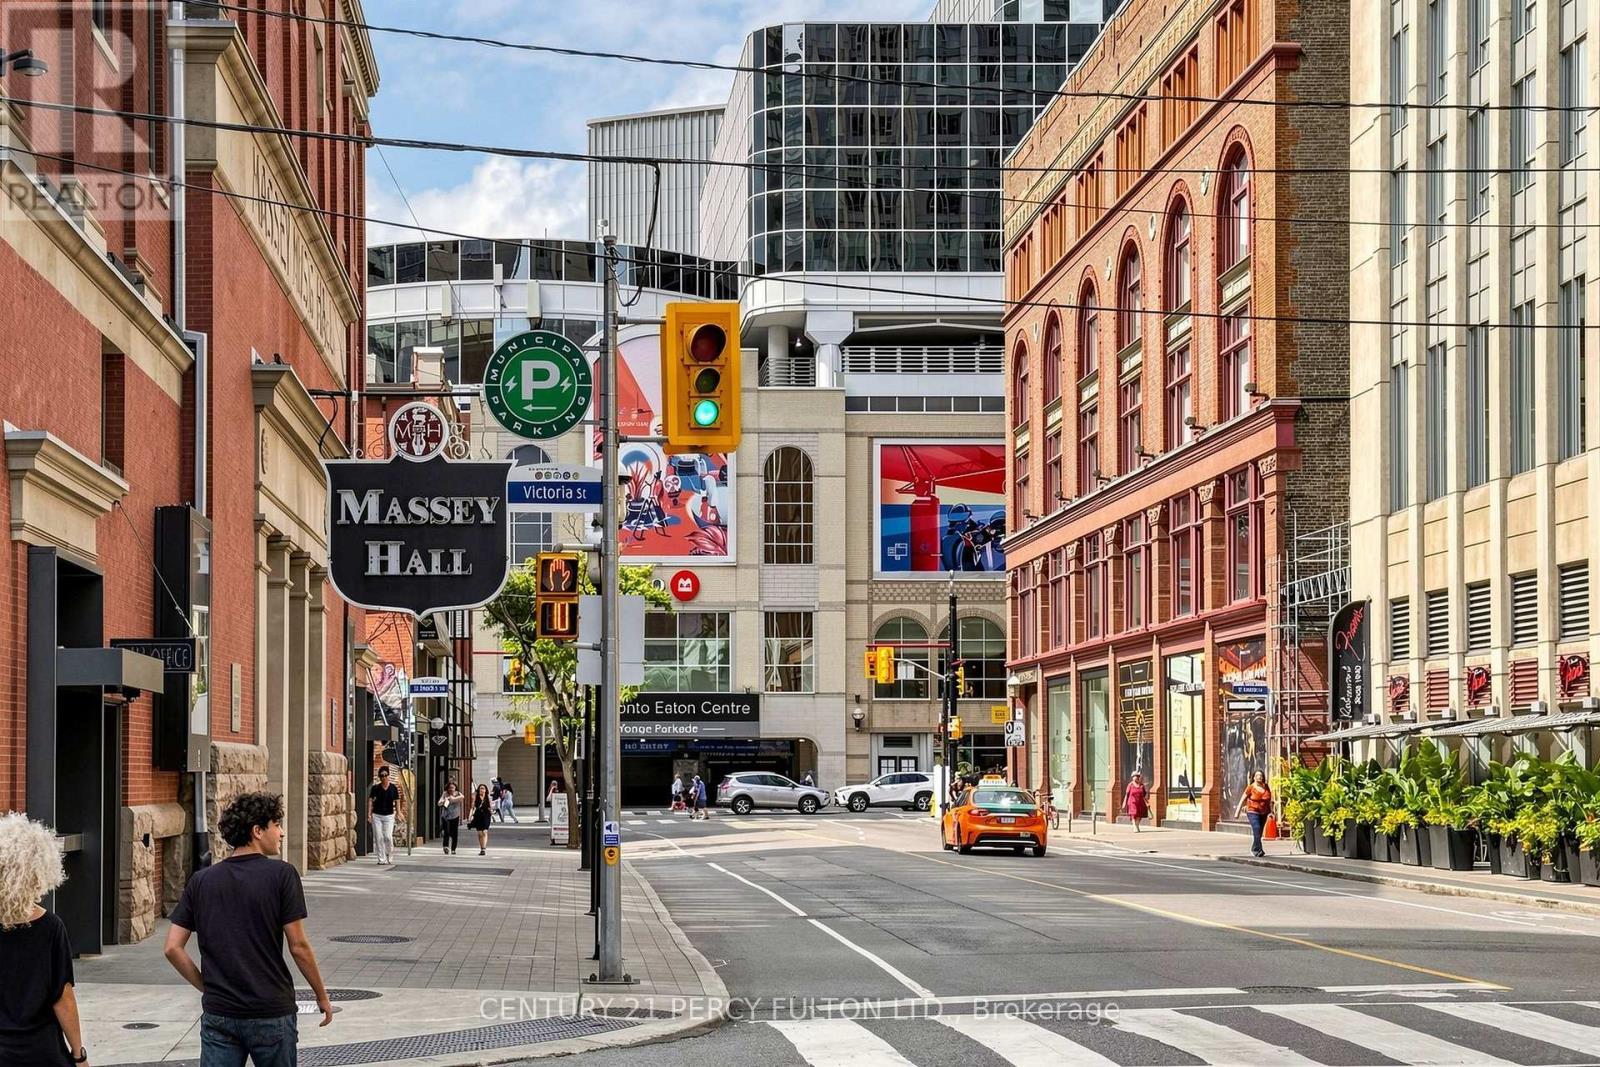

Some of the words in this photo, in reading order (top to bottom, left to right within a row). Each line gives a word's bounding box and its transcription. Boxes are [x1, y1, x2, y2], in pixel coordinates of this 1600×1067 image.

[490, 336, 586, 381] MUNICIPAL
[521, 360, 560, 400] P
[491, 395, 586, 436] PARKING
[523, 485, 573, 499] Victoria
[576, 488, 587, 499] St
[619, 701, 650, 715] onto
[655, 701, 696, 715] Eaton
[701, 701, 751, 715] Centre
[655, 723, 698, 733] Parkade
